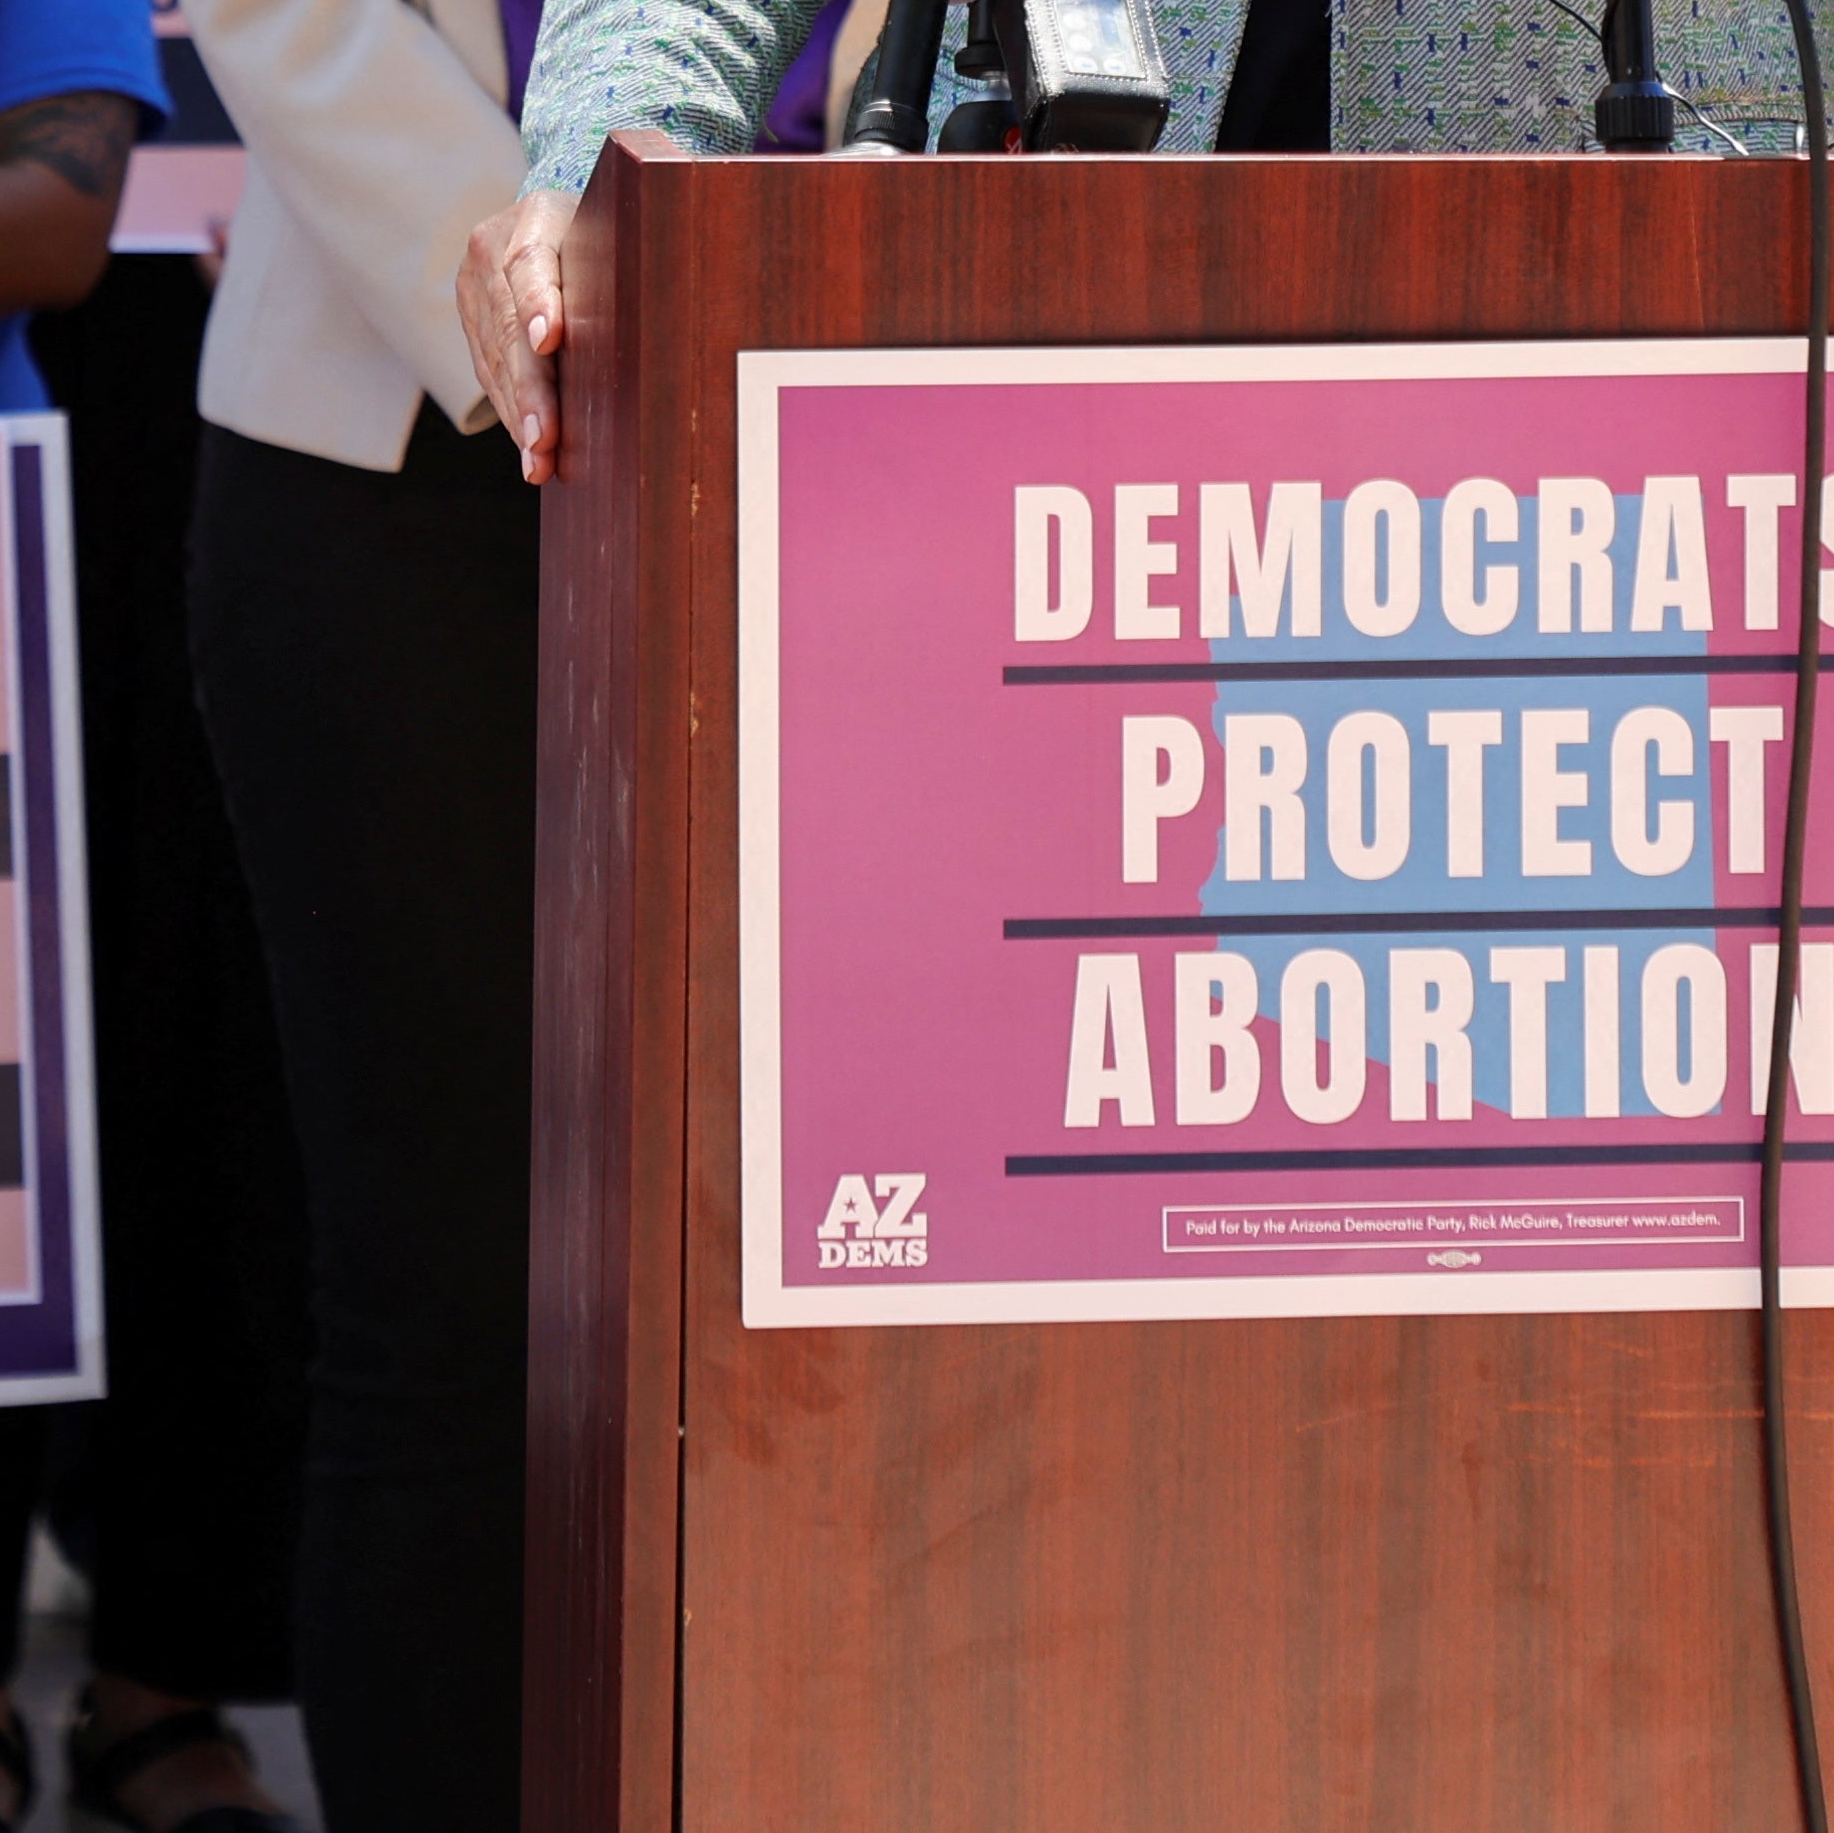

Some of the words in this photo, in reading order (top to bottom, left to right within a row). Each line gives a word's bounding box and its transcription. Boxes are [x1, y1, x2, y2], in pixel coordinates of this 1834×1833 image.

[1119, 706, 1784, 884] PROTECT
[816, 1172, 928, 1240] AZ
[1185, 1219, 1217, 1236] Paid
[1220, 1219, 1241, 1236] for
[1243, 1219, 1260, 1238] by
[1263, 1218, 1286, 1235] the
[1289, 1217, 1341, 1234] Arizona
[1344, 1215, 1424, 1233] Democratic
[1427, 1214, 1466, 1234] Party,
[1468, 1213, 1497, 1231] Rick
[1500, 1213, 1563, 1231] McGuire,
[1566, 1212, 1629, 1230] Treasurer
[817, 1238, 929, 1269] DEMS
